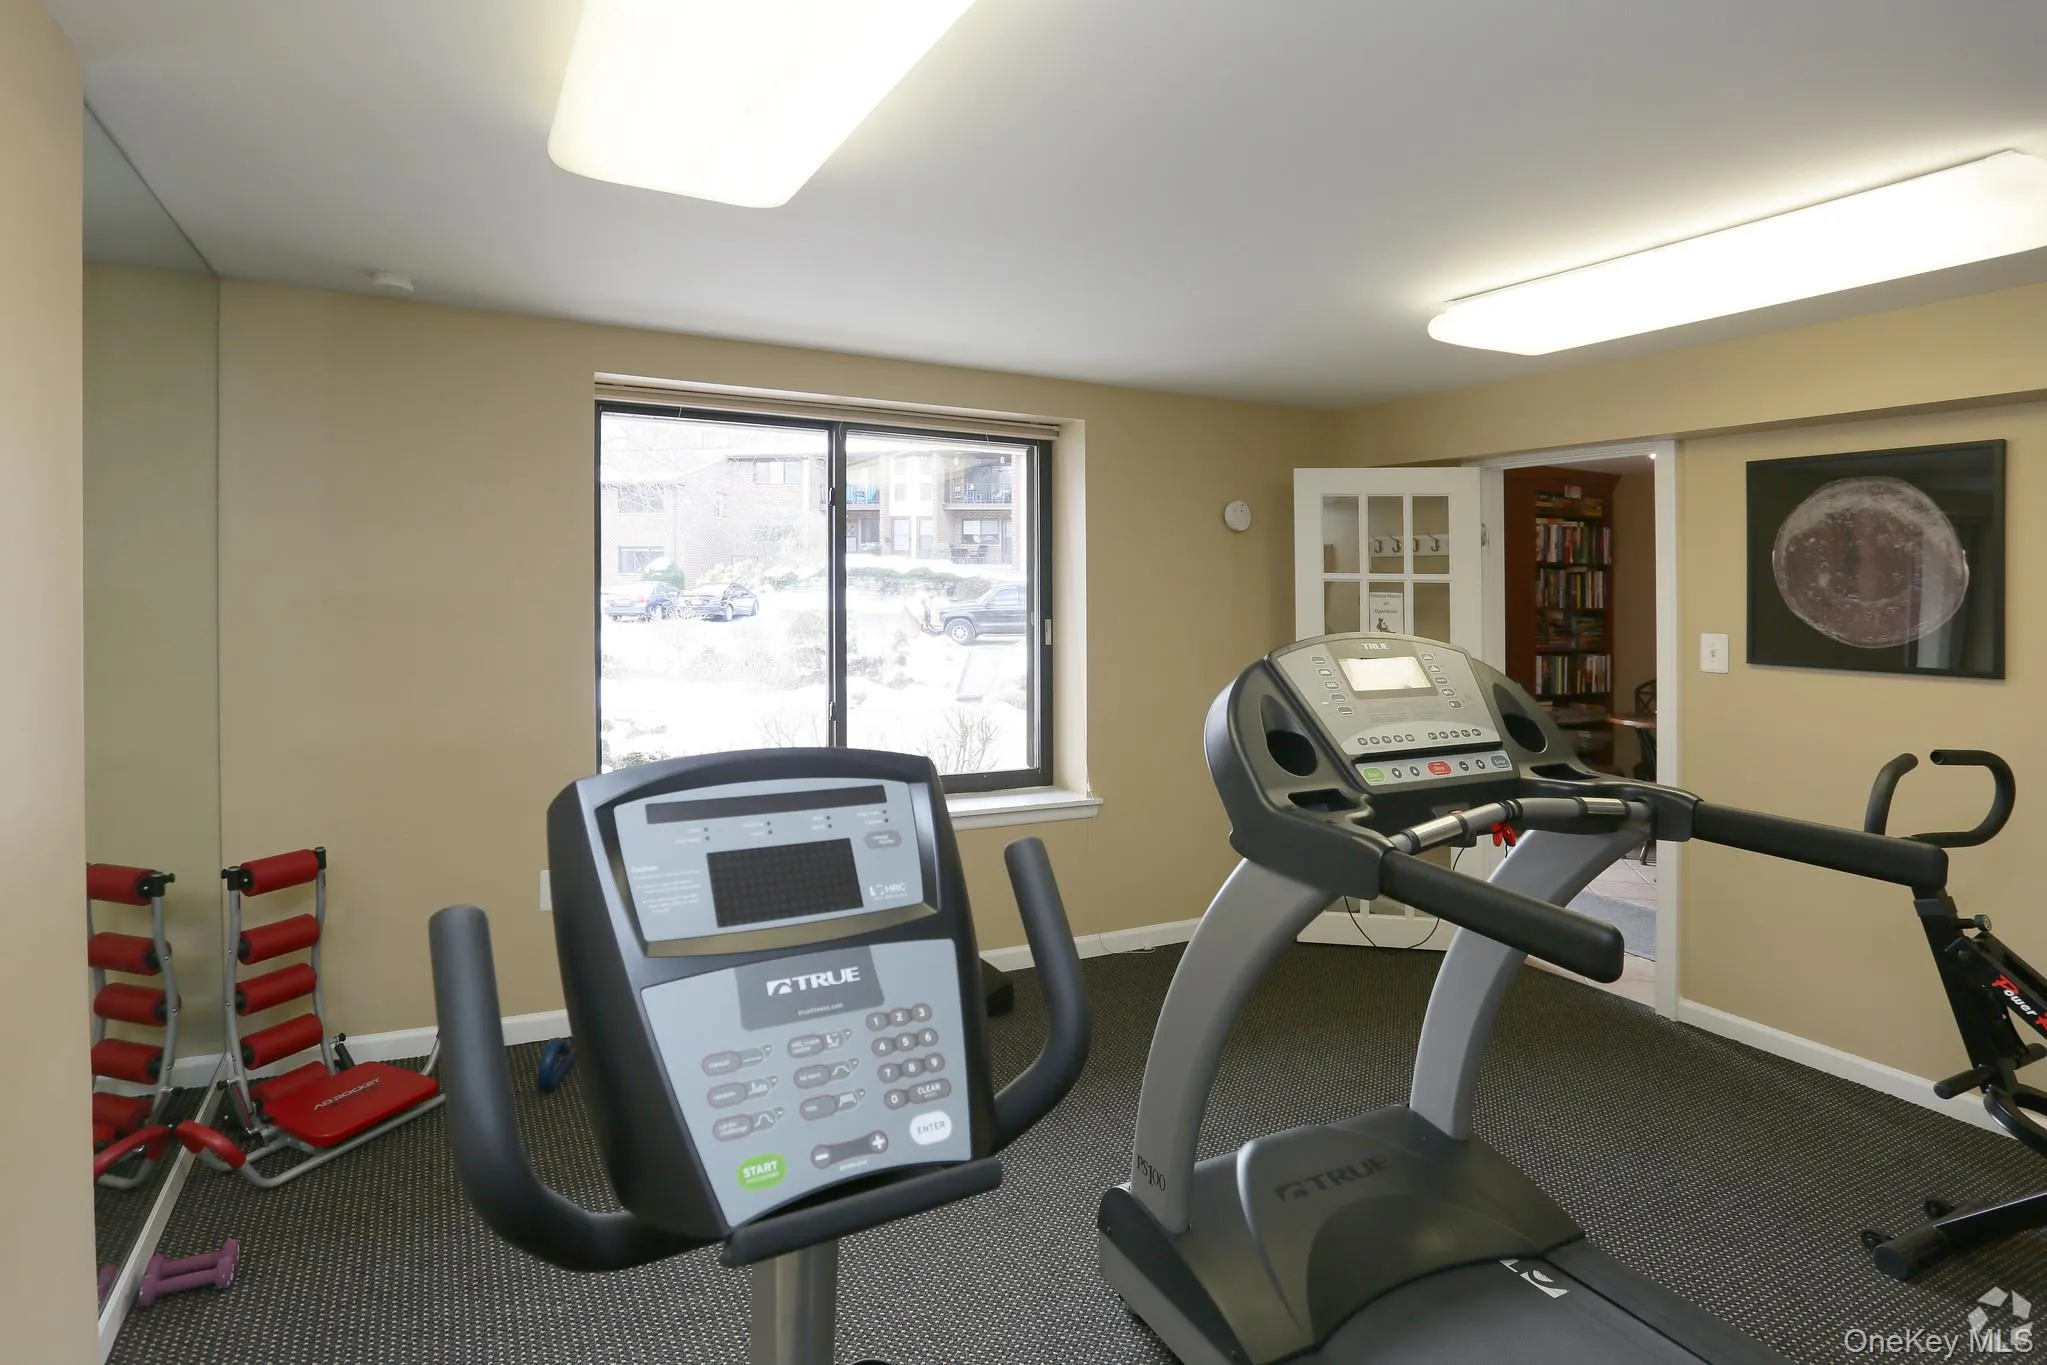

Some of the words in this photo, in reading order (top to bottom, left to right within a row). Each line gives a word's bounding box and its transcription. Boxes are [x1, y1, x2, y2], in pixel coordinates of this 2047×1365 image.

[792, 966, 861, 991] TRUE
[1991, 974, 2038, 1015] Power
[896, 1013, 903, 1022] 2
[918, 1008, 925, 1017] 3
[902, 1037, 909, 1046] 5
[908, 1063, 915, 1072] 8
[931, 1058, 938, 1067] 9
[917, 1083, 941, 1095] CLEAR
[917, 1120, 945, 1135] ENTER
[743, 1160, 778, 1178] START
[1137, 1154, 1166, 1192] PS100
[1305, 1154, 1390, 1191] TRUE
